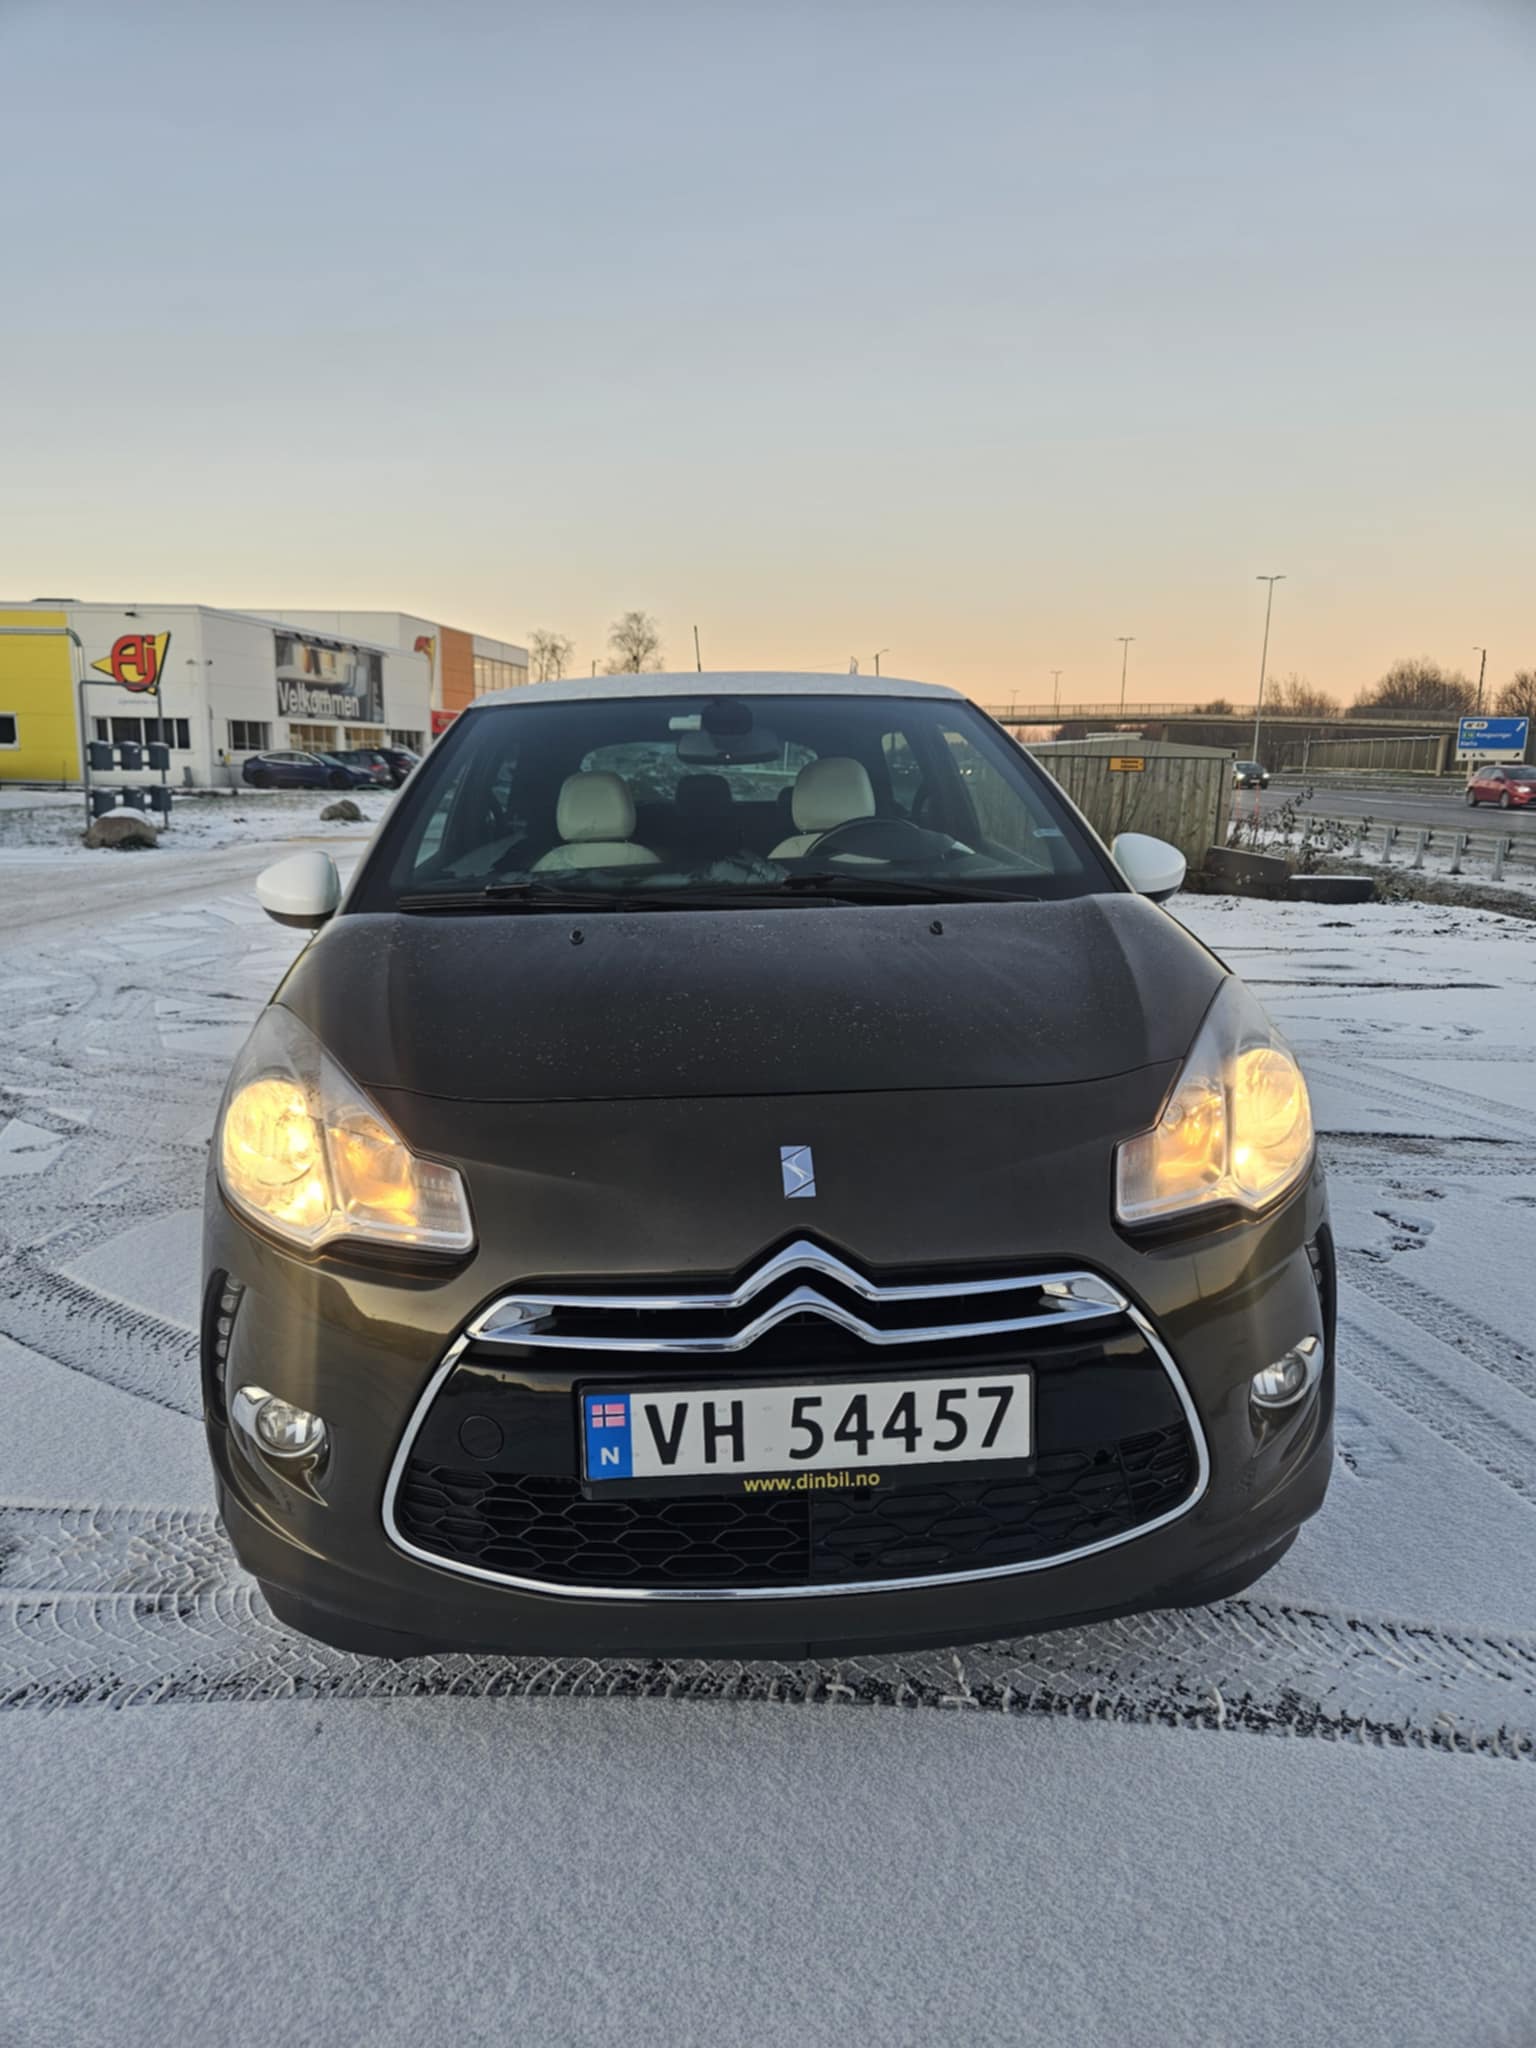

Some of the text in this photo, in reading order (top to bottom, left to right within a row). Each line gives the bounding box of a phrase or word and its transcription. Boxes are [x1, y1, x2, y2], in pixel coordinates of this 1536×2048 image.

[278, 680, 361, 718] Velkommen
[644, 1386, 1014, 1465] VH 54457
[601, 1446, 620, 1466] N
[743, 1471, 881, 1493] www.dinbil.no
